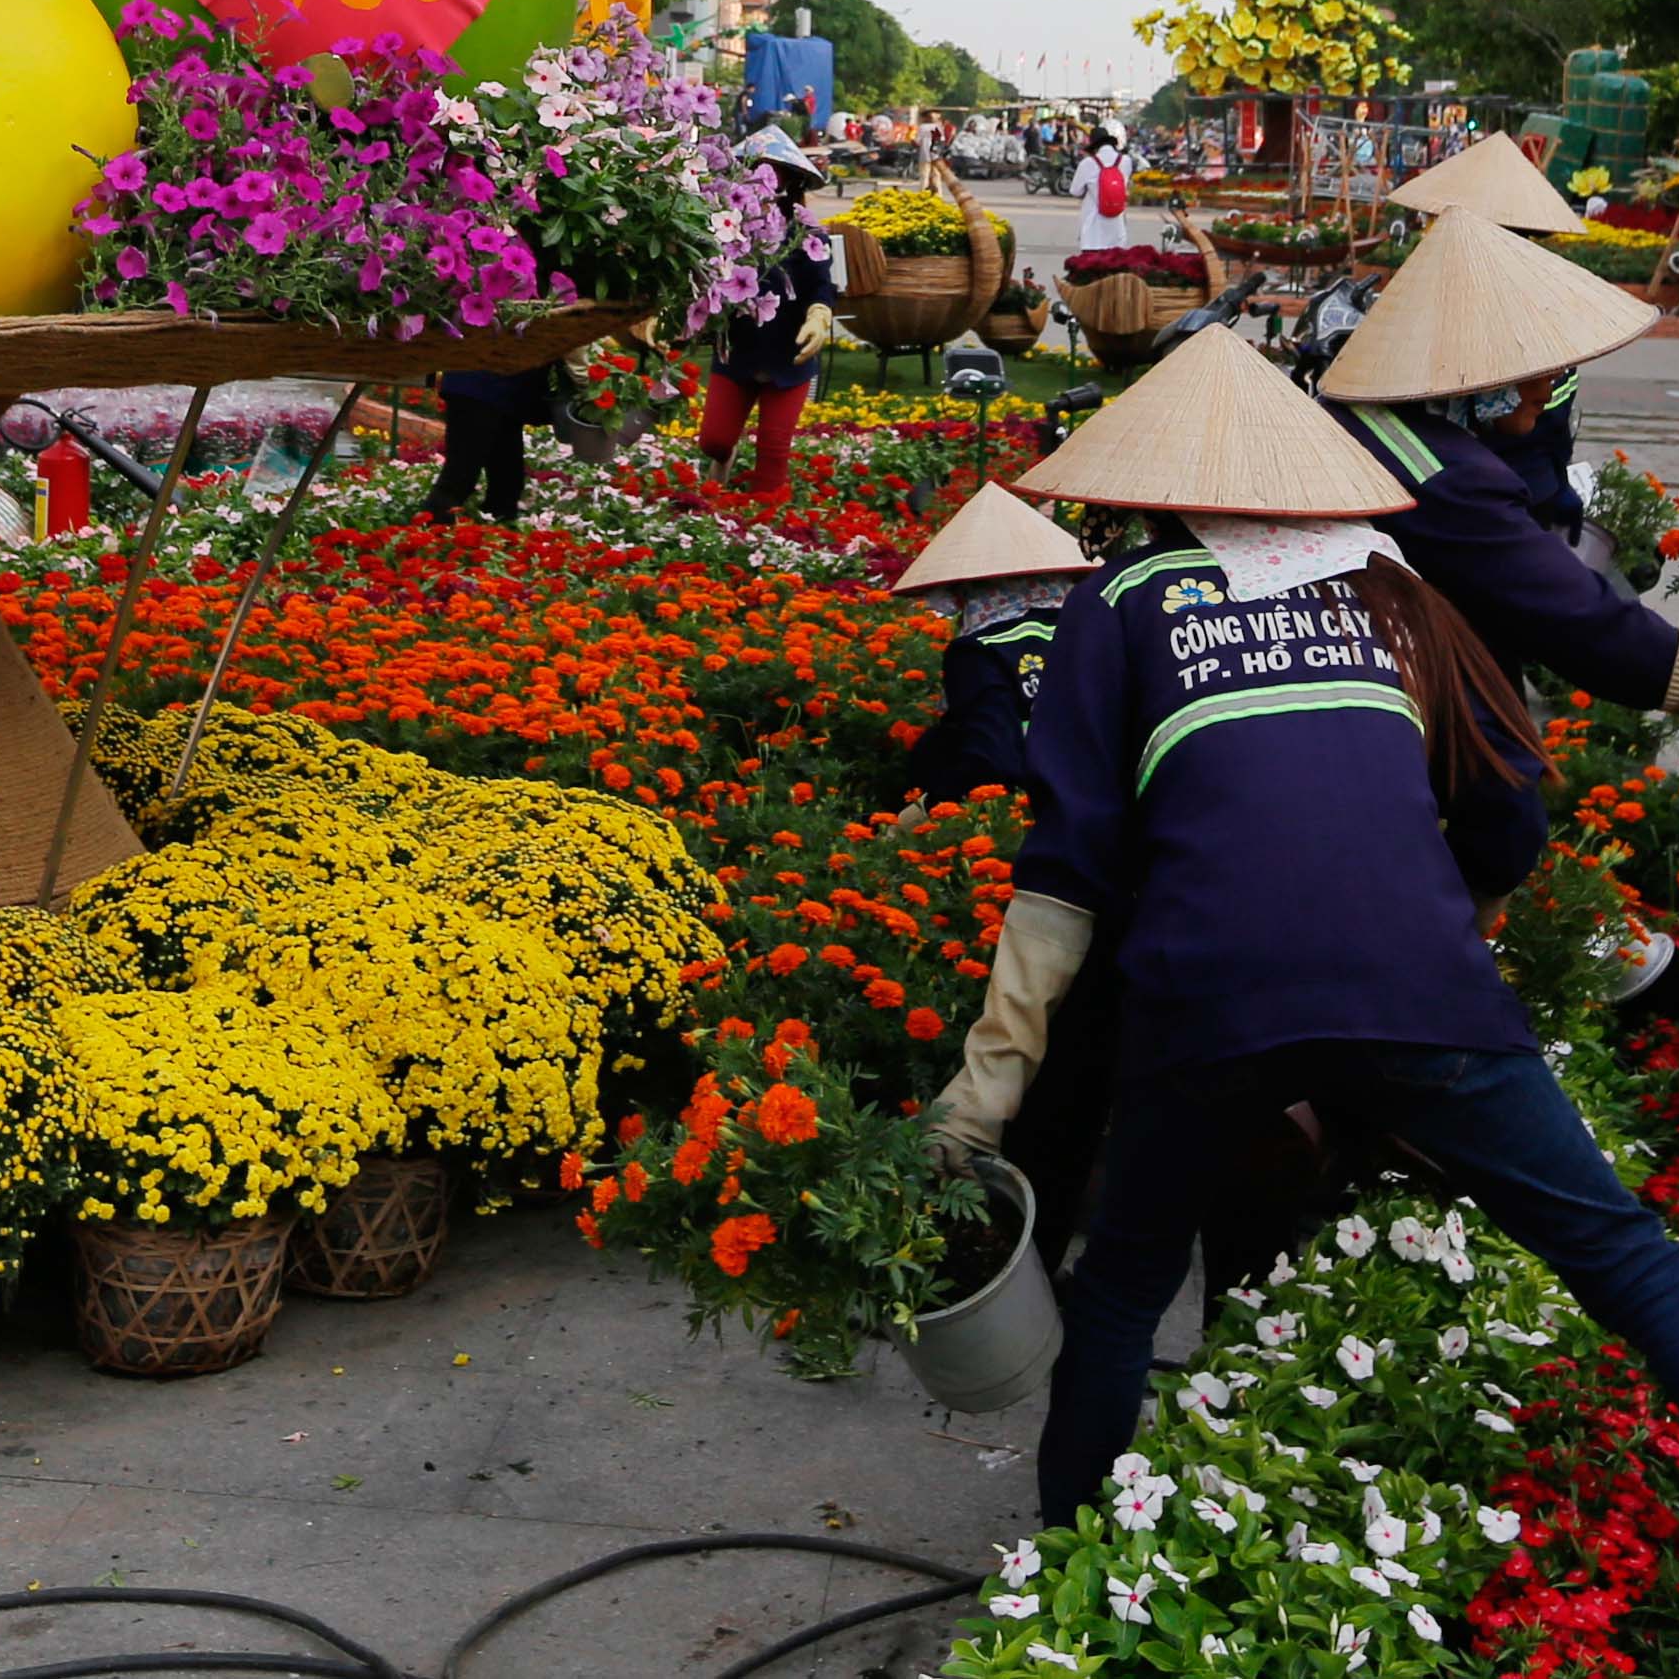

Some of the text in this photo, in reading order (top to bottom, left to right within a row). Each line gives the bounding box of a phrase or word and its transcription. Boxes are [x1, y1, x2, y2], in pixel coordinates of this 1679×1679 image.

[1170, 603, 1372, 660] CÔNG VIÊN CÂY
[1178, 658, 1231, 690] TP.
[1242, 641, 1292, 674] HỒ
[1304, 641, 1364, 668] CHÍ
